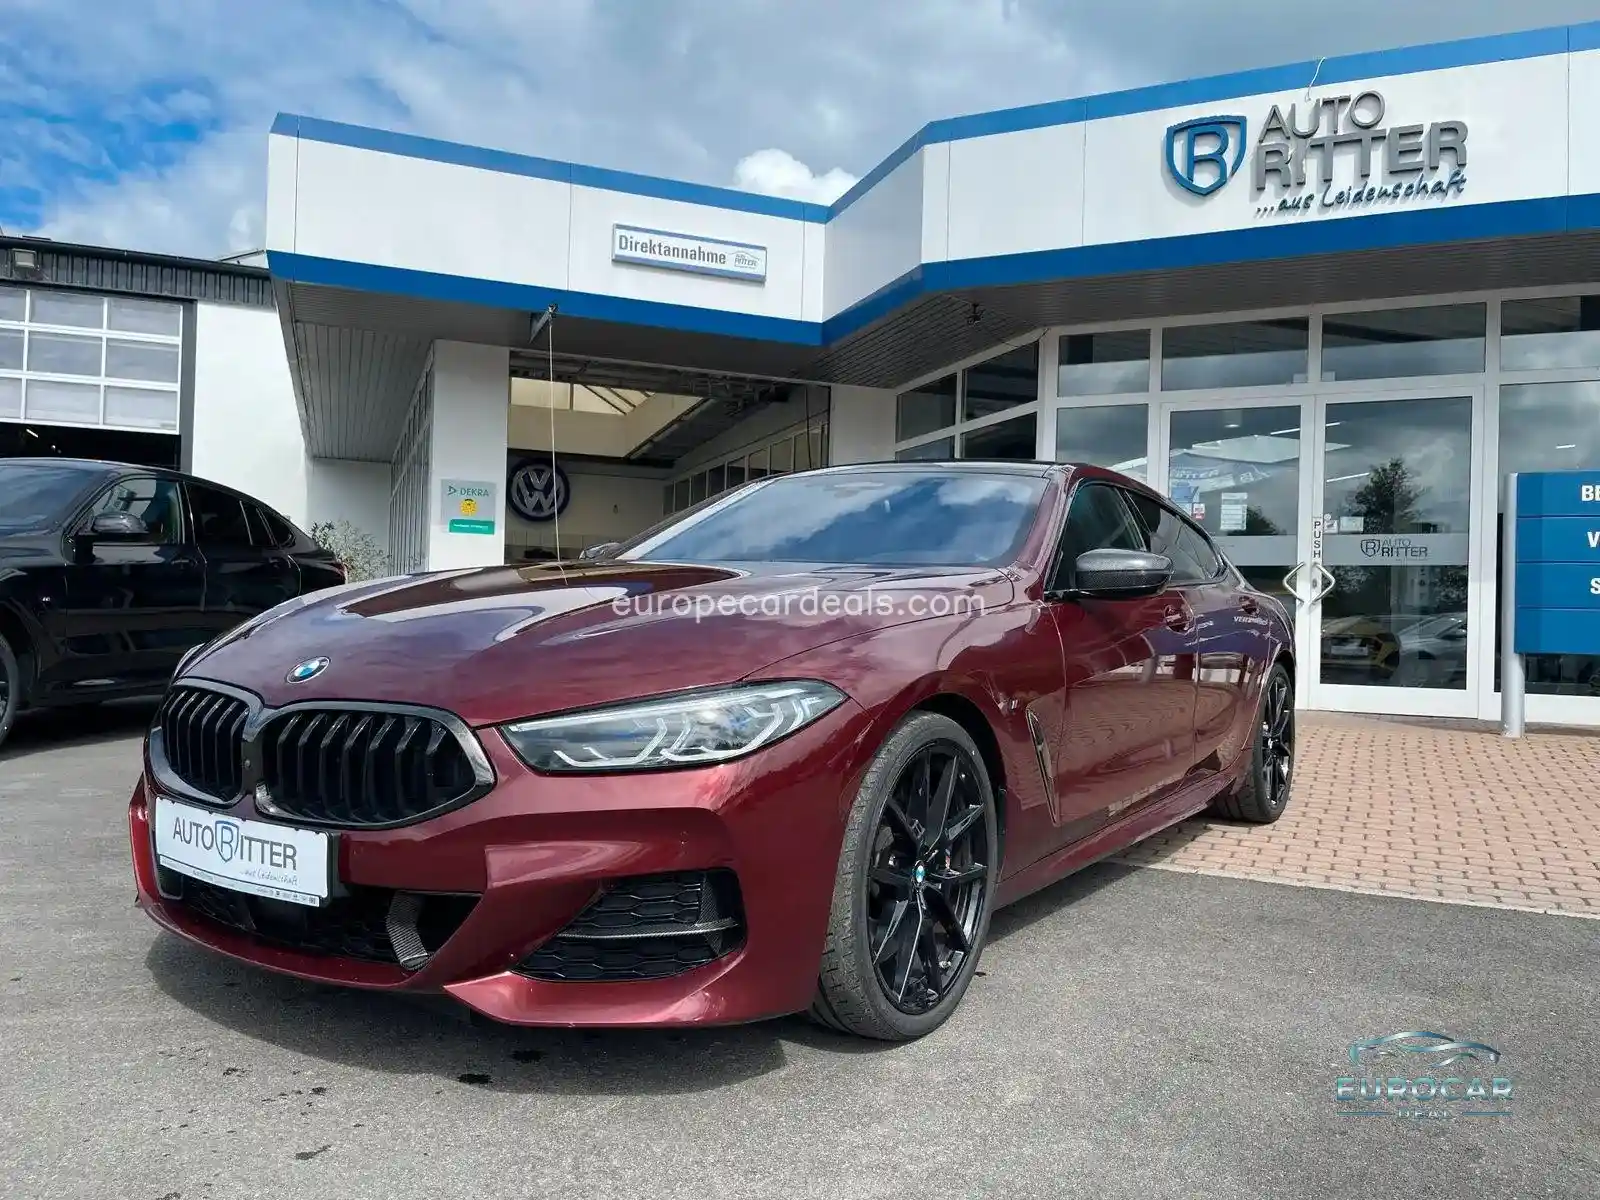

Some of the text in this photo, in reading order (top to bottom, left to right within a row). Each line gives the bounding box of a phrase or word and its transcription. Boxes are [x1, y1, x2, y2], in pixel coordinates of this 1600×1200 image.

[1258, 90, 1386, 143] AUTO
[1256, 120, 1468, 191] RITTER
[1322, 169, 1467, 208] Leidenschaft
[618, 234, 727, 265] Direktannahme
[460, 487, 490, 497] DEKRA
[1313, 521, 1321, 558] PUSH
[1381, 546, 1428, 557] RITTER
